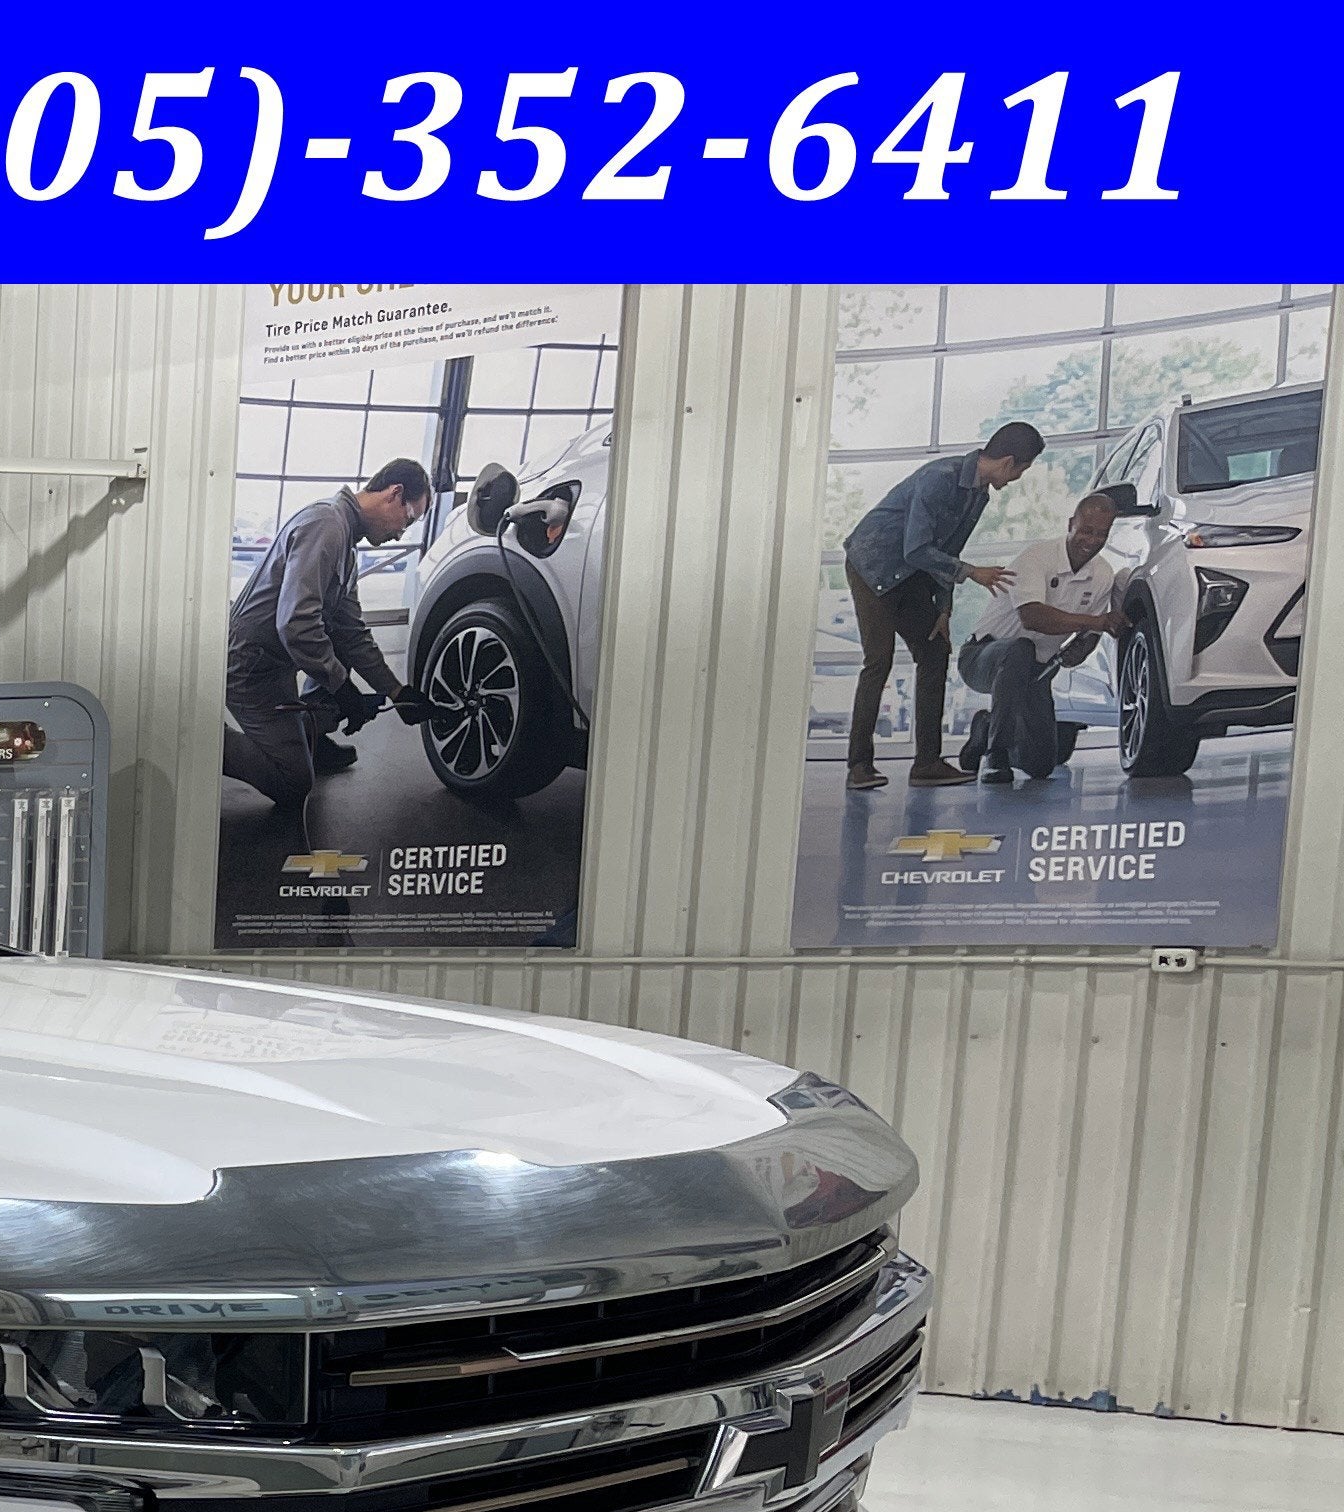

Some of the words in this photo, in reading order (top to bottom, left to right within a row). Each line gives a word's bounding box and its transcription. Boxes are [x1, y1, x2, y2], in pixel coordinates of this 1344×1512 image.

[264, 344, 290, 354] Provide
[301, 340, 316, 350] with
[323, 337, 346, 347] better
[347, 334, 373, 346] eligible
[374, 331, 393, 342] price
[403, 327, 416, 336] the
[417, 324, 434, 334] time
[435, 322, 443, 331] of
[444, 318, 482, 332] purchase,
[483, 314, 497, 324] and
[517, 307, 542, 318] match
[265, 323, 291, 337] Tire
[294, 319, 328, 334] Price
[332, 311, 373, 329] Match
[377, 301, 452, 322] Guarantee.
[263, 355, 279, 364] Find
[285, 353, 307, 362] better
[308, 350, 327, 360] price
[328, 347, 350, 357] within
[362, 343, 379, 353] days
[380, 341, 388, 350] of
[389, 340, 401, 348] the
[440, 332, 454, 341] and
[474, 325, 500, 336] refund
[501, 322, 514, 331] the
[1030, 821, 1186, 851] CERTIFIED
[389, 843, 507, 870] CERTIFIED
[1028, 854, 1156, 882] SERVICE
[279, 884, 372, 898] CHEVROLET
[387, 871, 485, 896] SERVICE
[881, 869, 1006, 885] CHEVROLET
